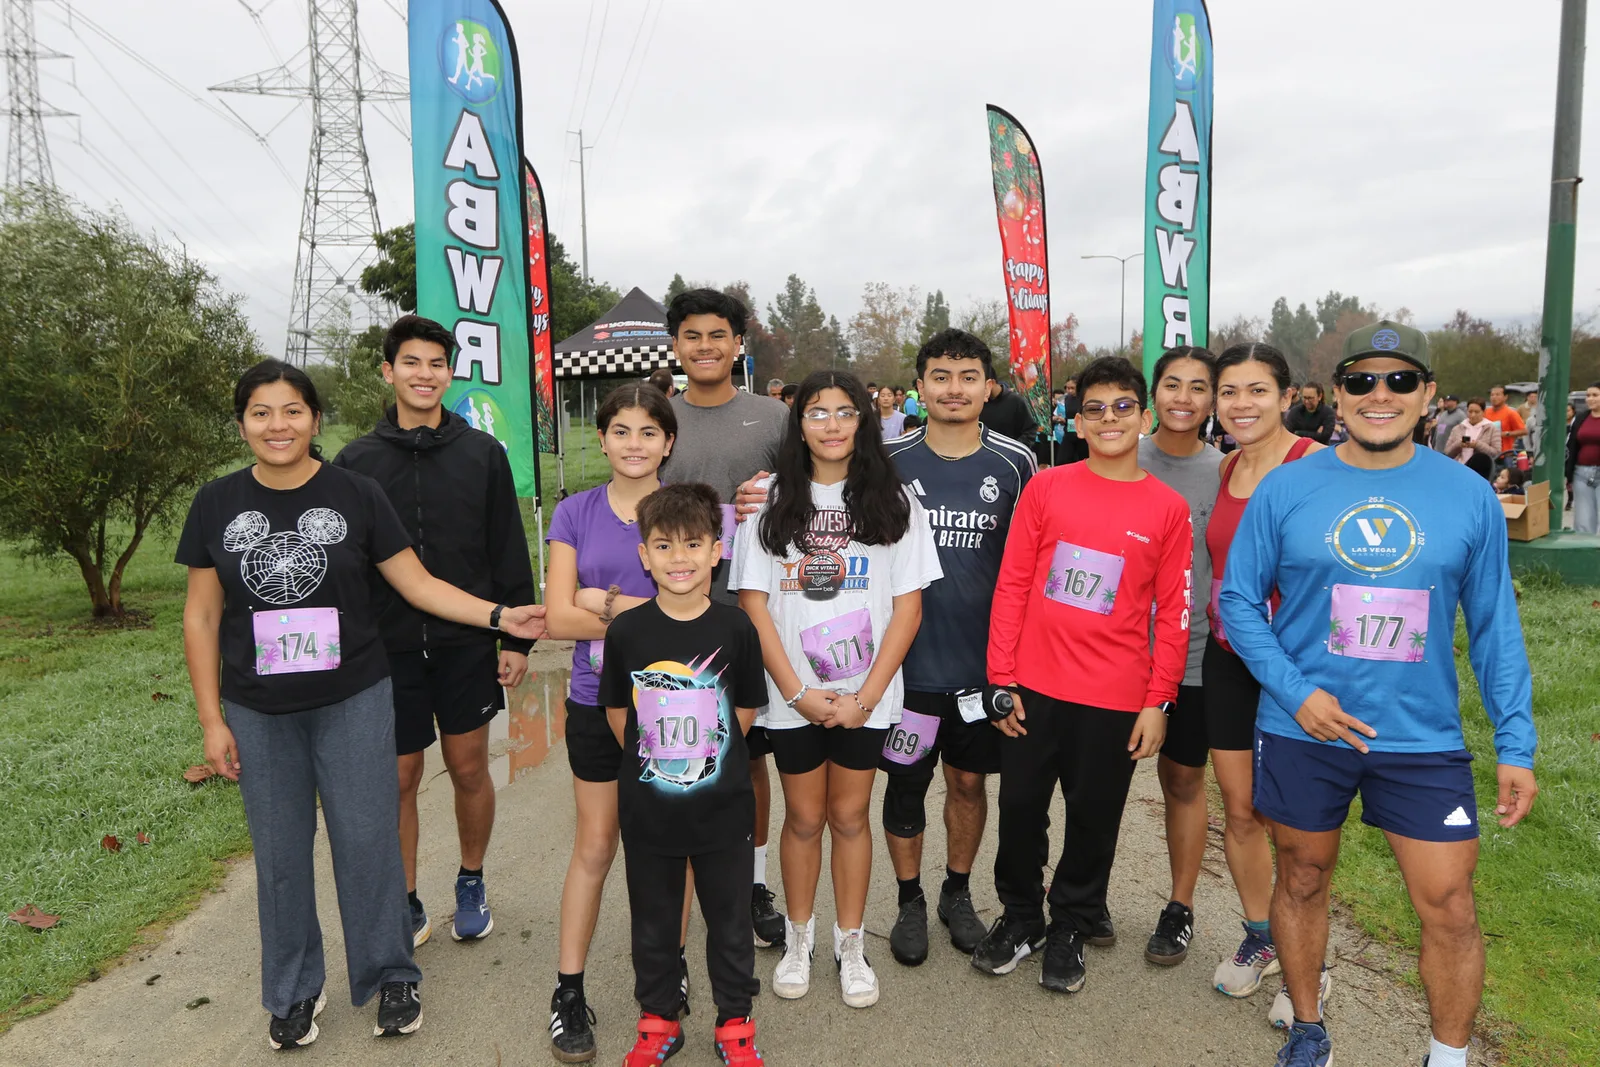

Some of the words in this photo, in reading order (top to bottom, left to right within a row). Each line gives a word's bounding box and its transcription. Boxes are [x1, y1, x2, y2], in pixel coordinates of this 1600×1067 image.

[924, 505, 998, 531] mirates
[805, 532, 850, 551] Baby!
[939, 529, 984, 549] BETTER
[1063, 567, 1104, 600] 167
[1181, 569, 1191, 630] PFG
[276, 631, 320, 662] 174
[1356, 613, 1406, 649] 177
[826, 635, 864, 671] 171
[655, 715, 699, 749] 170
